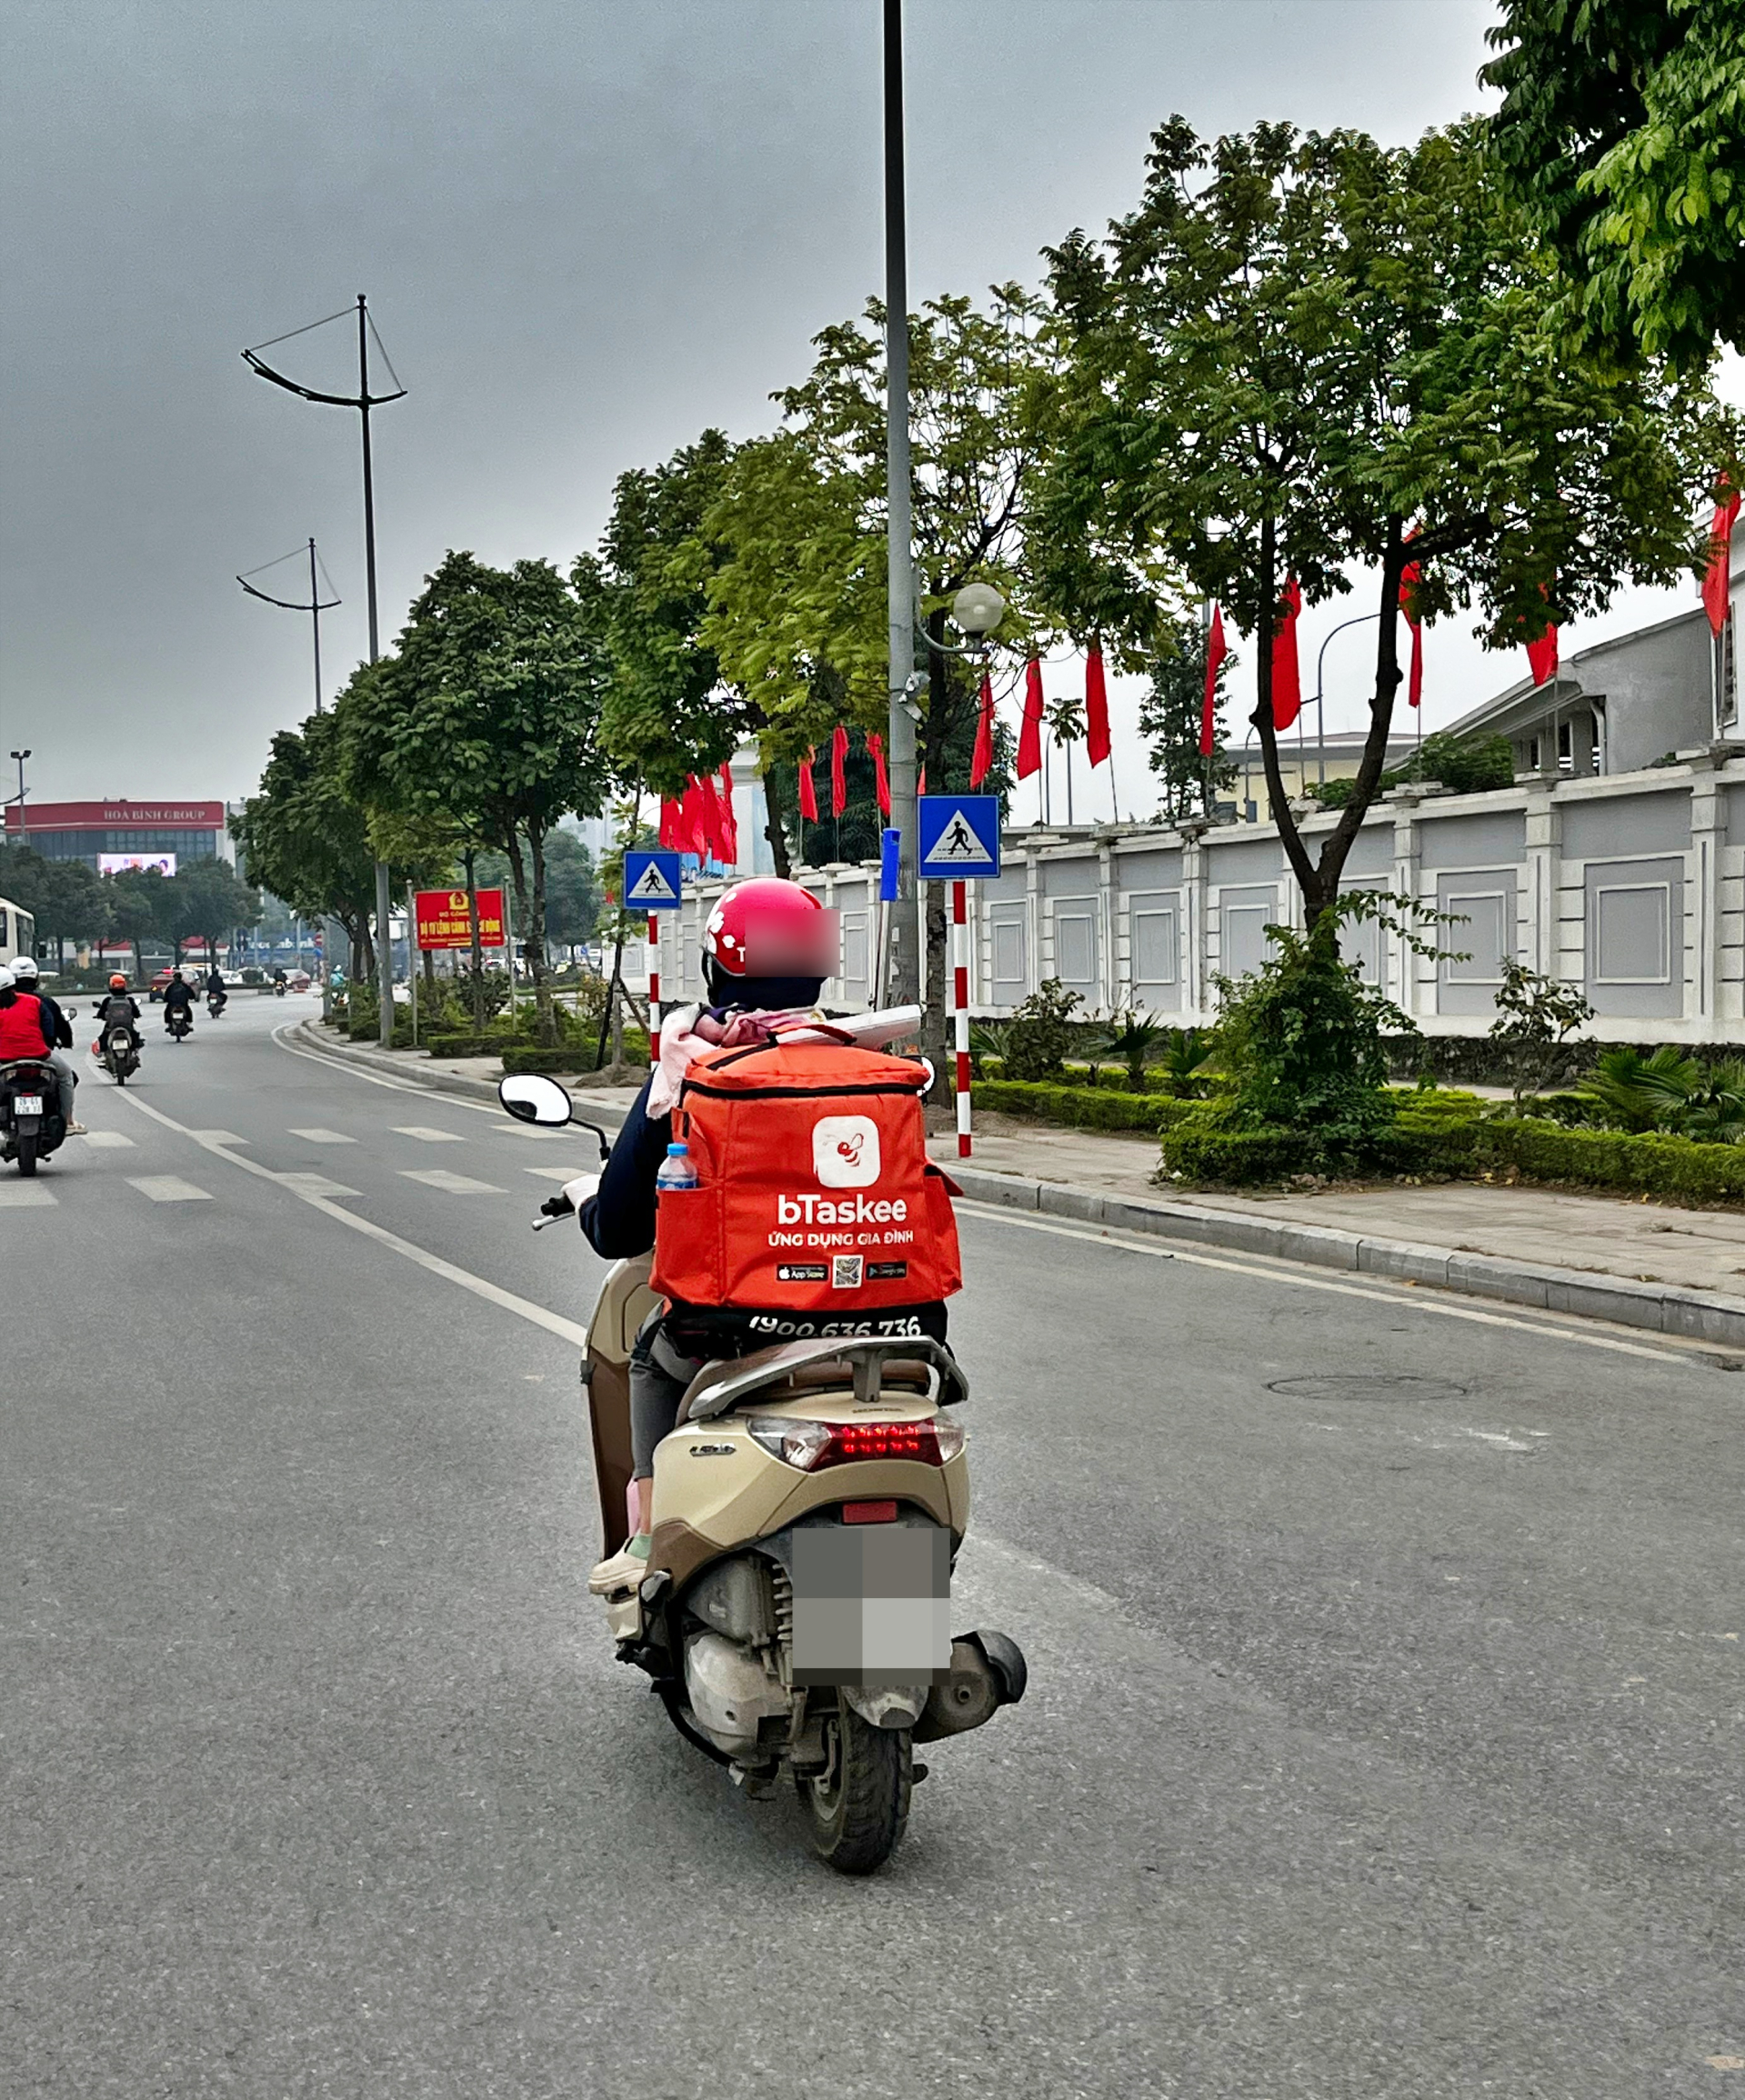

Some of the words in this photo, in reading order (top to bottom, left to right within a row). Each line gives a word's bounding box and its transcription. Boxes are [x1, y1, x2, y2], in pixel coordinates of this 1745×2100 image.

[163, 810, 206, 819] GROUP
[777, 1194, 908, 1225] bTaskee
[768, 1231, 804, 1246] ỨNG
[807, 1233, 853, 1248] DỤNG
[857, 1233, 880, 1245] GIA
[884, 1229, 914, 1245] ĐÌNH
